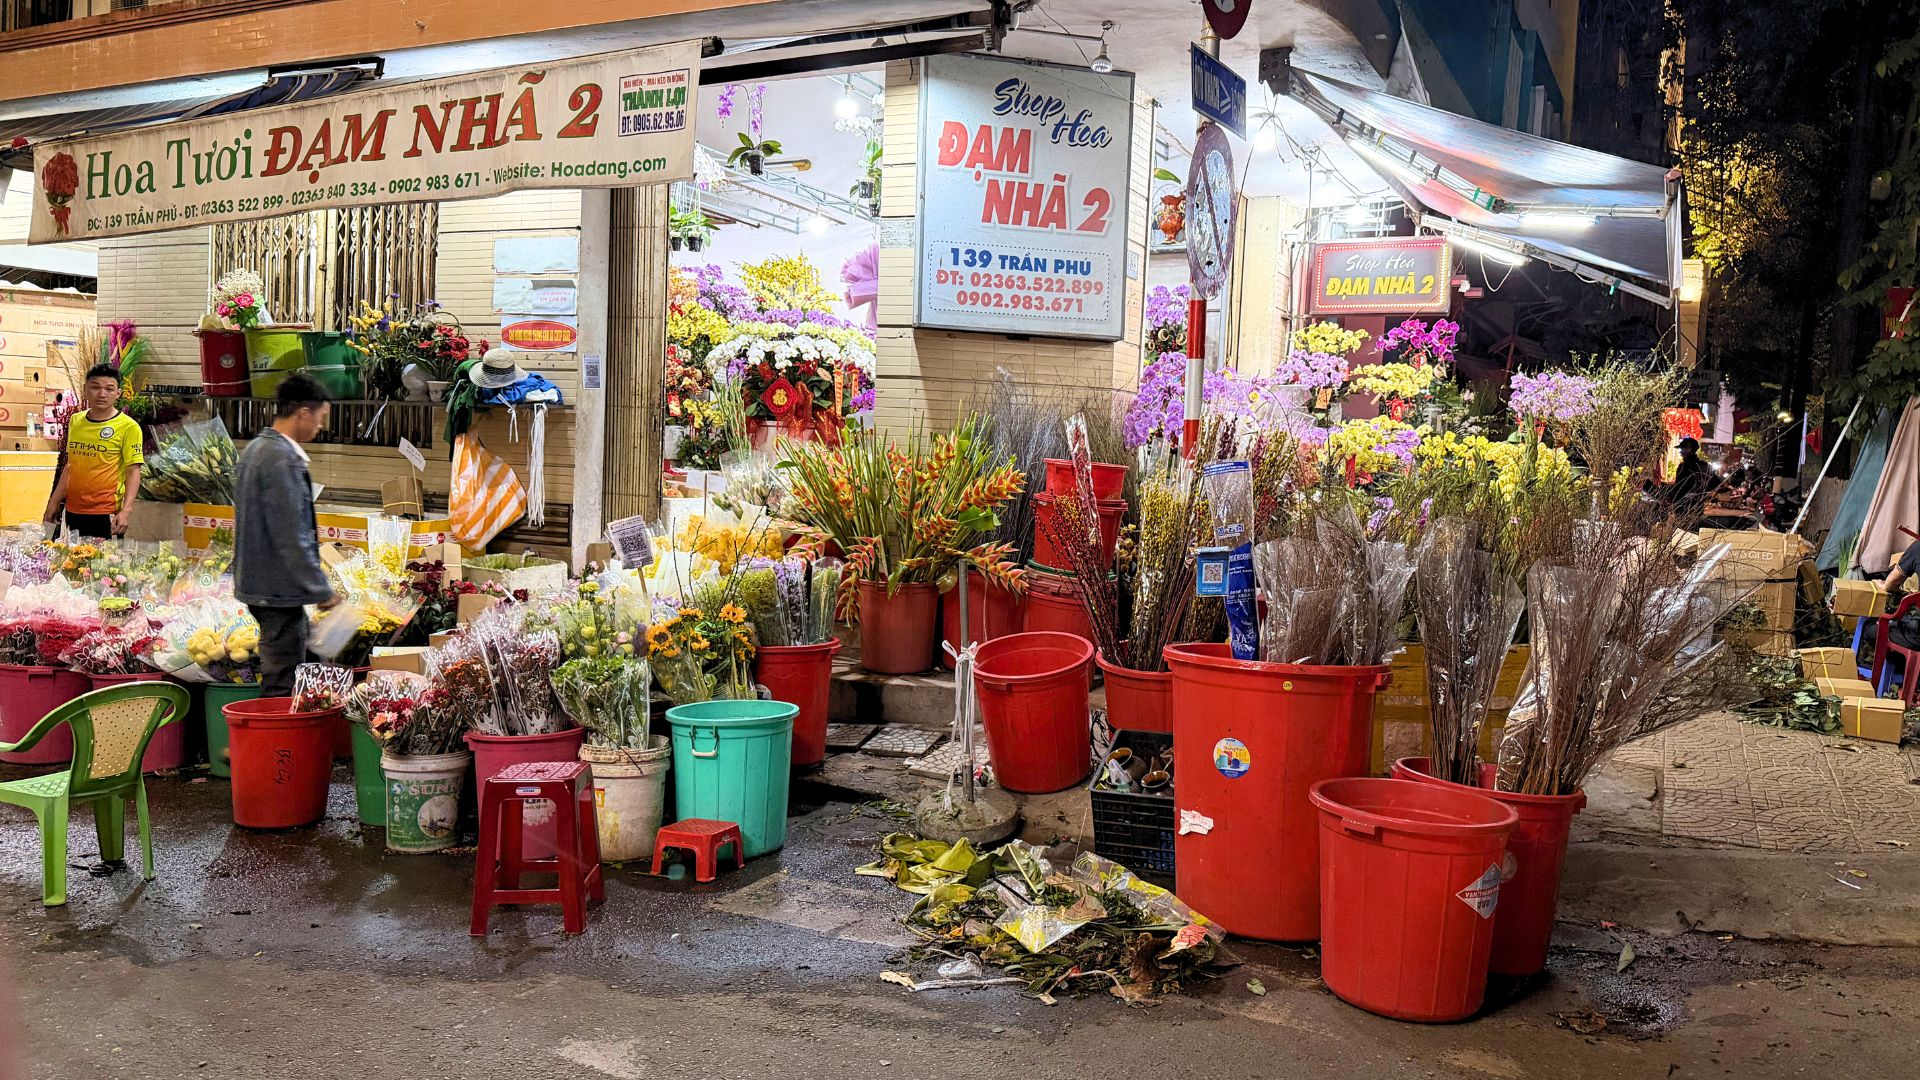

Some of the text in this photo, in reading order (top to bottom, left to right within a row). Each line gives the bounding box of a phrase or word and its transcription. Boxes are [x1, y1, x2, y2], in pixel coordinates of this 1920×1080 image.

[622, 87, 664, 111] THÀNH
[992, 77, 1113, 148] Shop Hoa
[86, 70, 603, 200] Hoa Tươi ĐẠM NHÃ 2
[622, 110, 685, 133] ĐT: 0905.62.95.06
[937, 120, 1033, 182] ĐẠM
[105, 213, 122, 228] 139
[126, 205, 154, 226] TRẦN
[184, 207, 199, 220] ĐT:
[200, 200, 234, 217] 02363
[238, 198, 260, 212] 522
[263, 195, 284, 210] 899
[291, 187, 324, 206] 02363
[327, 183, 346, 200] 840
[350, 181, 376, 197] 334
[388, 177, 421, 194] 0902
[425, 174, 450, 190] 983
[454, 172, 480, 188] 671
[493, 161, 545, 184] Website:
[551, 156, 667, 179] Hoadang.com
[981, 173, 1112, 233] NHÃ 2
[951, 247, 1093, 276] 139 TRẦN PHÚ
[1345, 250, 1415, 273] Shop Hoa
[935, 270, 1104, 296] ĐT: 02363.522.899
[1326, 271, 1435, 300] ĐẠM NHÃ 2
[956, 290, 1084, 313] 0902.983.671
[68, 441, 108, 453] ETIHAD
